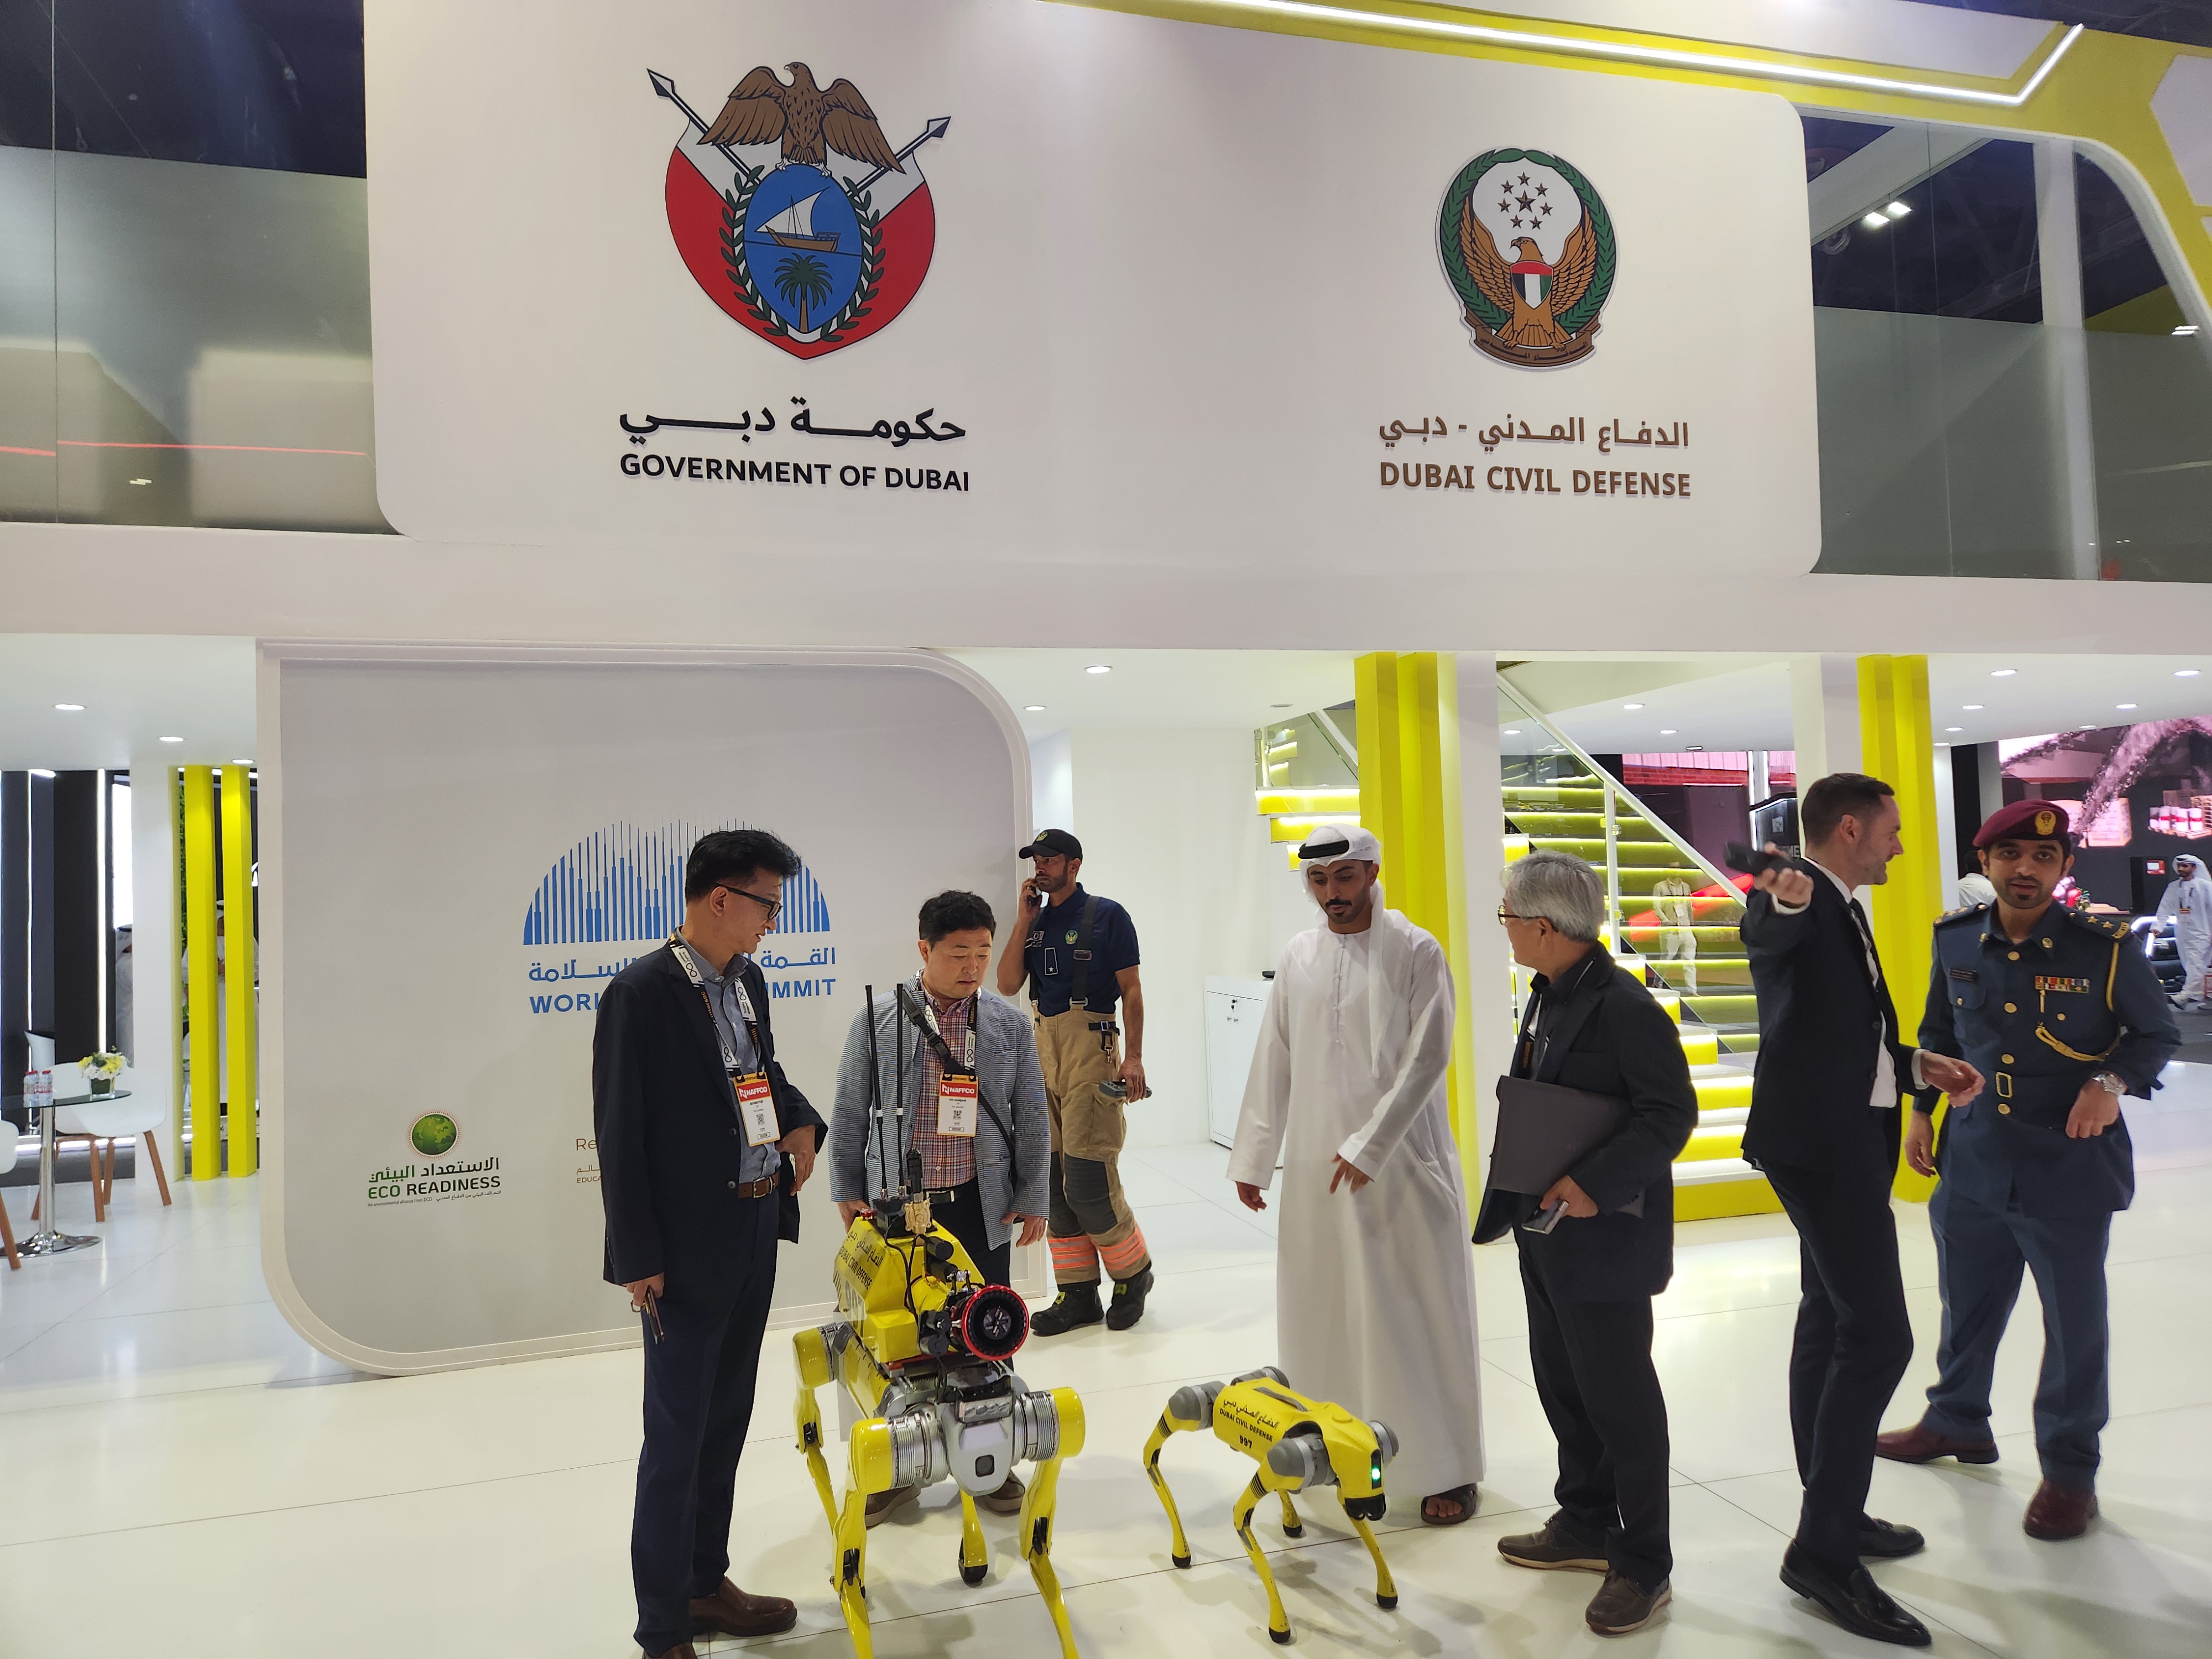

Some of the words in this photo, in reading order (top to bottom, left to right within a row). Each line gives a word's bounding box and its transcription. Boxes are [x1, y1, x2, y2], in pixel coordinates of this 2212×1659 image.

[619, 407, 776, 445] دبي
[790, 396, 966, 447] حكومة
[1380, 415, 1448, 448] دبي
[1479, 413, 1585, 452] المدني
[1598, 418, 1689, 453] الدفاع
[620, 453, 832, 485] GOVERNMENT
[839, 465, 877, 487] OF
[884, 467, 969, 491] DUBAI
[1380, 461, 1475, 489] DUBAI
[1486, 466, 1562, 492] CIVIL
[1573, 469, 1692, 497] DEFENSE
[760, 947, 836, 969] القمة
[765, 978, 836, 999] MMIT
[746, 1086, 768, 1097] NAFFCO
[421, 1157, 499, 1177] الاستعداد
[368, 1185, 400, 1199] ECO
[407, 1176, 500, 1196] READINESS
[848, 1256, 858, 1274] CIVIL
[855, 1266, 873, 1290] DEFENSE
[1219, 1407, 1235, 1422] DUBAI
[1235, 1417, 1248, 1430] CIVIL
[1249, 1424, 1273, 1442] DEFENSE
[1239, 1434, 1253, 1449] 997
